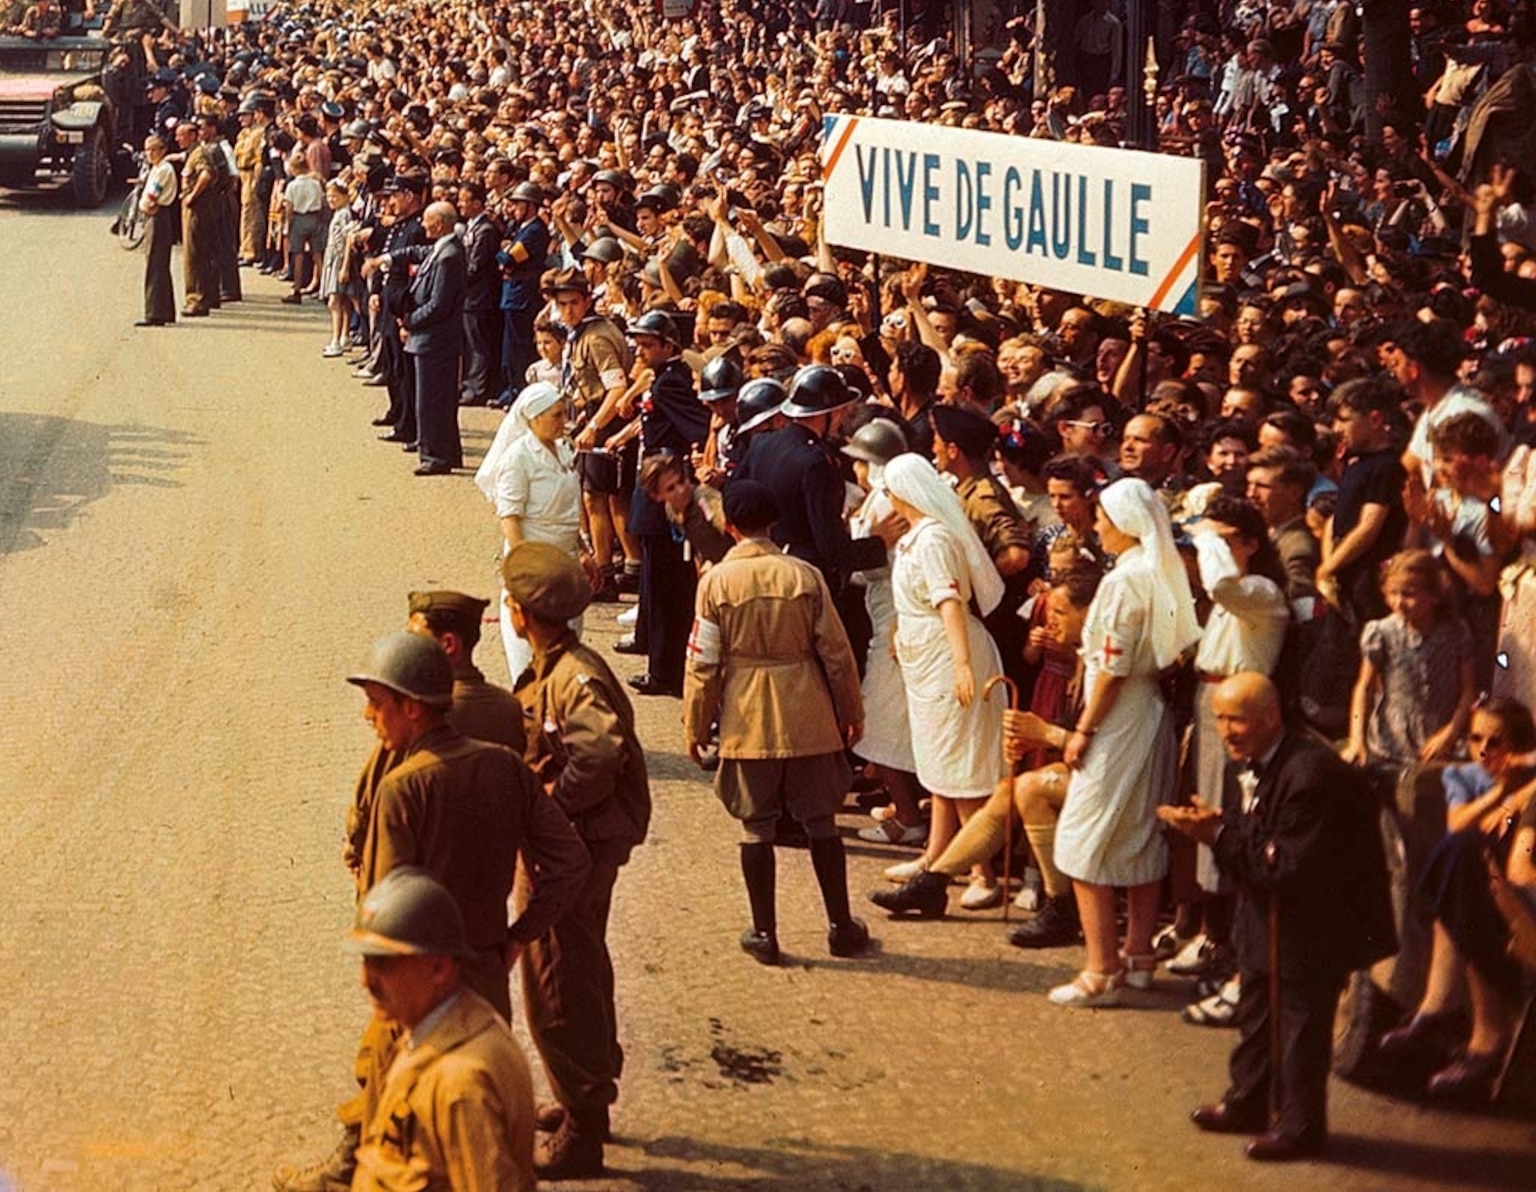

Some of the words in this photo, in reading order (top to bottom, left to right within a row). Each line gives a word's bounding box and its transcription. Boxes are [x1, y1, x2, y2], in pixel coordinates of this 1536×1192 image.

[854, 143, 940, 237] VIVE
[955, 157, 993, 248] DE
[1003, 165, 1152, 277] GAULLE
